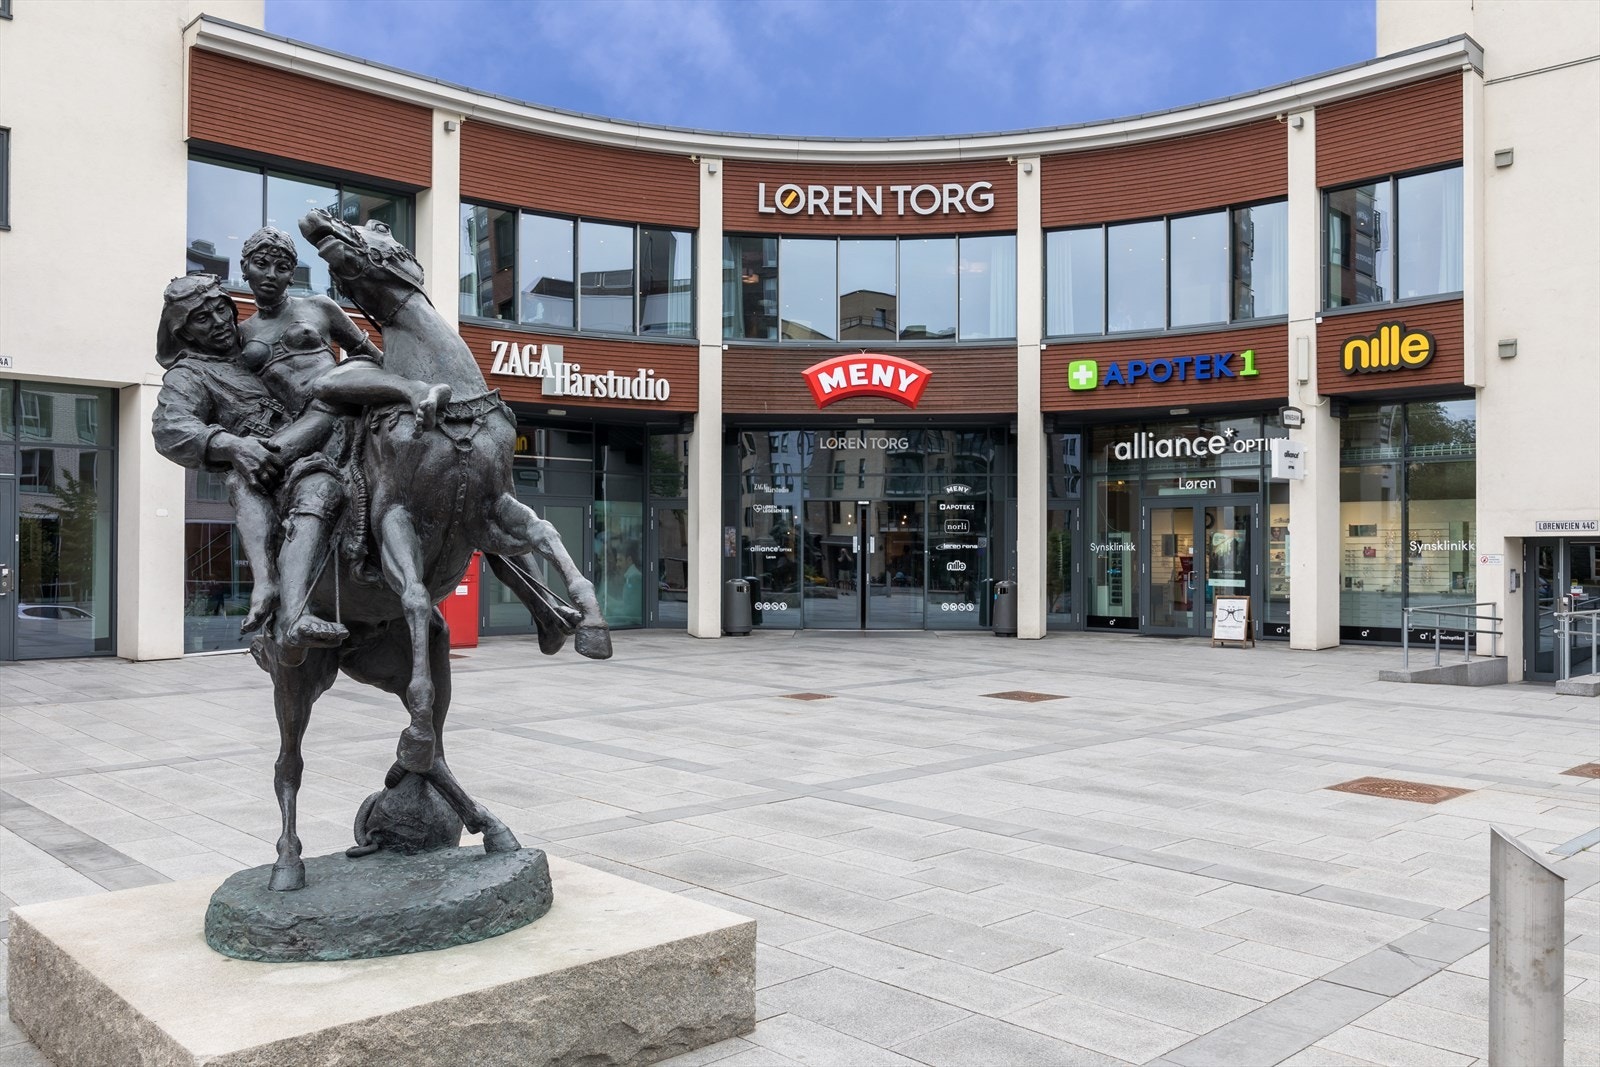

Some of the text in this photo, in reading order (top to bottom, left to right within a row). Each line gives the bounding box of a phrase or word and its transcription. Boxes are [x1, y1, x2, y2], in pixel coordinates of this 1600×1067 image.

[758, 181, 995, 217] LØREN TORG
[1344, 325, 1430, 370] nille
[490, 340, 671, 401] ZAGA Hårstudio
[1103, 350, 1260, 386] APOTEK 1
[817, 363, 919, 394] MENY
[820, 437, 909, 450] LØREN TORG
[946, 485, 969, 493] MENY
[1179, 477, 1217, 490] Løren
[947, 522, 967, 530] norli
[1538, 521, 1595, 531] LØRENVEIEN 44C
[1090, 542, 1136, 554] Synsklinikk
[1409, 540, 1476, 553] Synsklinikk
[947, 560, 966, 571] nille
